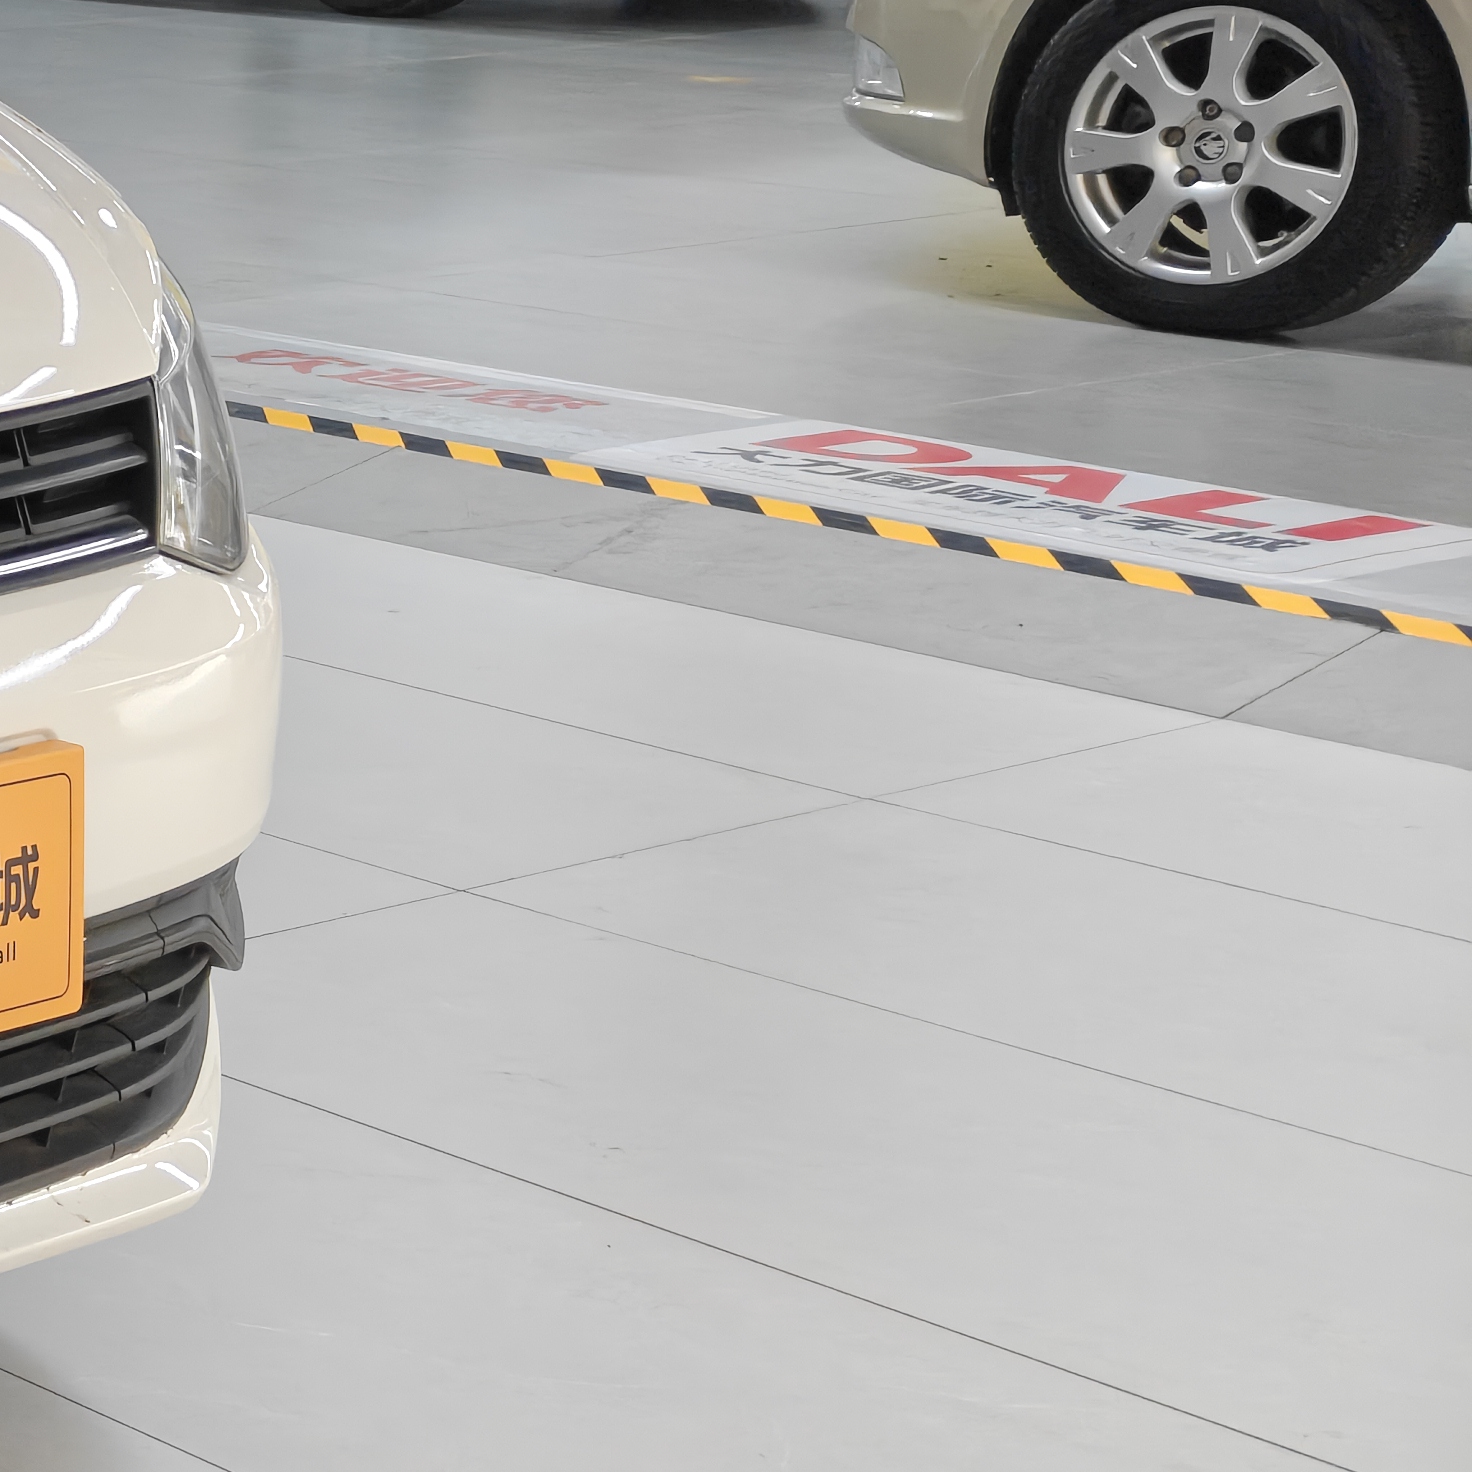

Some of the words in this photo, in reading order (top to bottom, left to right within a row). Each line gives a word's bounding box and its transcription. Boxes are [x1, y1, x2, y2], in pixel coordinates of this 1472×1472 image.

[691, 447, 1313, 553] 大力国际汽车城
[749, 429, 1434, 541] DALI
